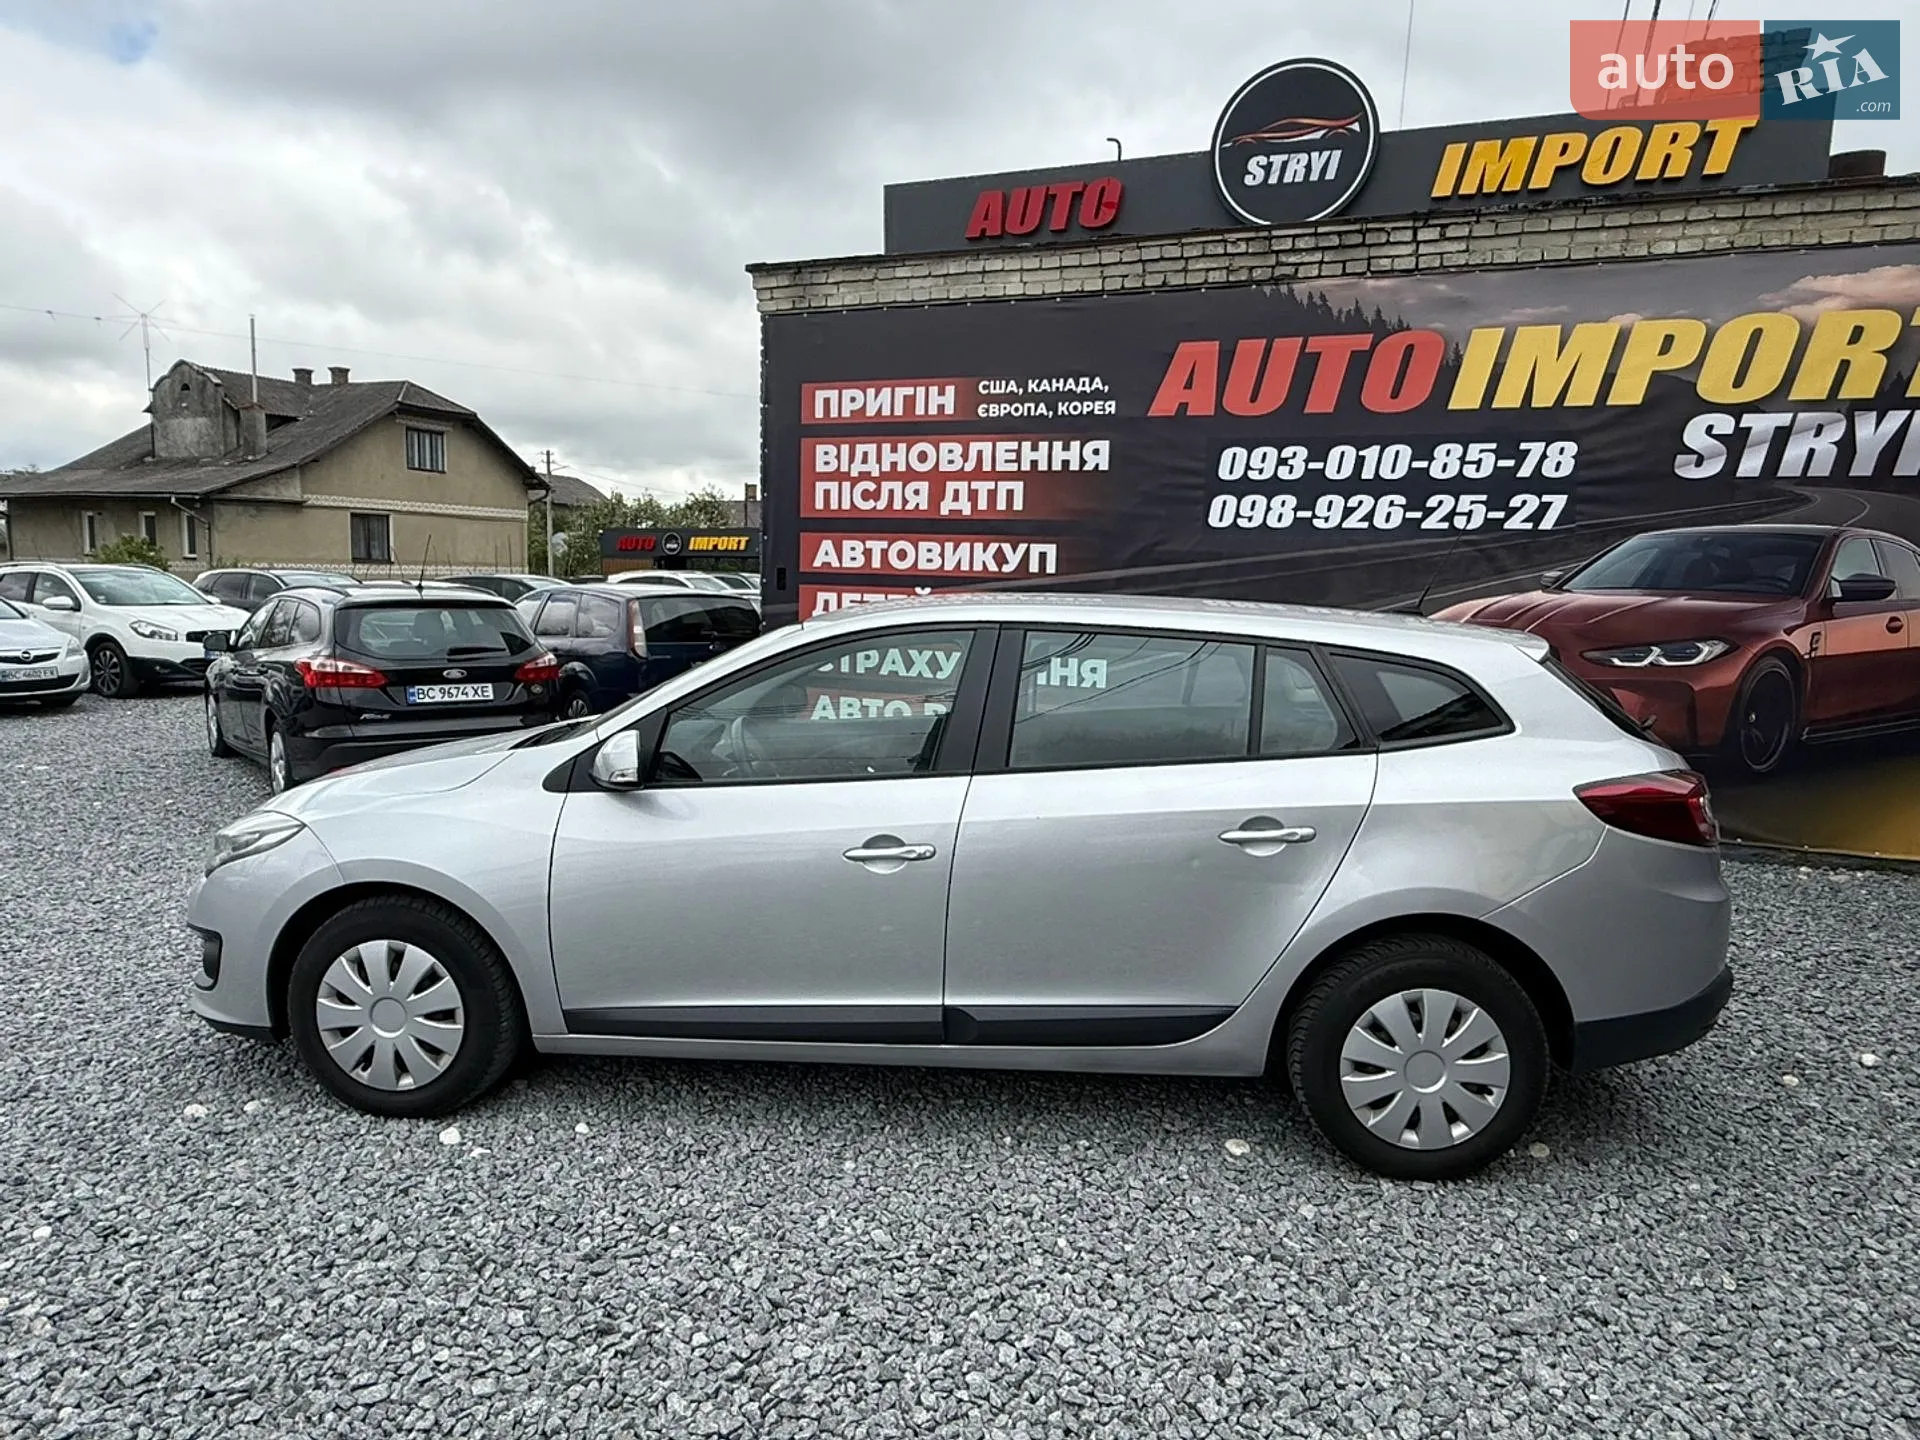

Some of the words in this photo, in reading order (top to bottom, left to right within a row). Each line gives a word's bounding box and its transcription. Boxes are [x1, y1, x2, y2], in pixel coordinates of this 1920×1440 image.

[966, 177, 1122, 237] AUTO
[1243, 149, 1343, 187] STRYI
[1431, 117, 1760, 198] IMPORT
[814, 385, 956, 419] ПРИГІН
[977, 378, 1024, 397] США,
[1027, 376, 1110, 396] КАНАДА,
[977, 401, 1054, 419] ЄВРОПА,
[1057, 399, 1117, 416] КОРЕЯ
[814, 439, 1111, 478] ВІДНОВЛЕННЯ
[1217, 440, 1579, 481] 093-010-85-78
[814, 480, 929, 511] ПІСЛЯ
[940, 481, 1025, 516] ДТП
[1207, 493, 1569, 530] 098-926-25-27
[616, 534, 657, 551] AUTO
[687, 535, 750, 551] IMPORT
[812, 539, 1058, 574] АВТОВИКУП
[416, 687, 437, 700] BC
[438, 686, 469, 699] 9674
[470, 685, 490, 698] XE
[810, 694, 913, 721] АВТО
